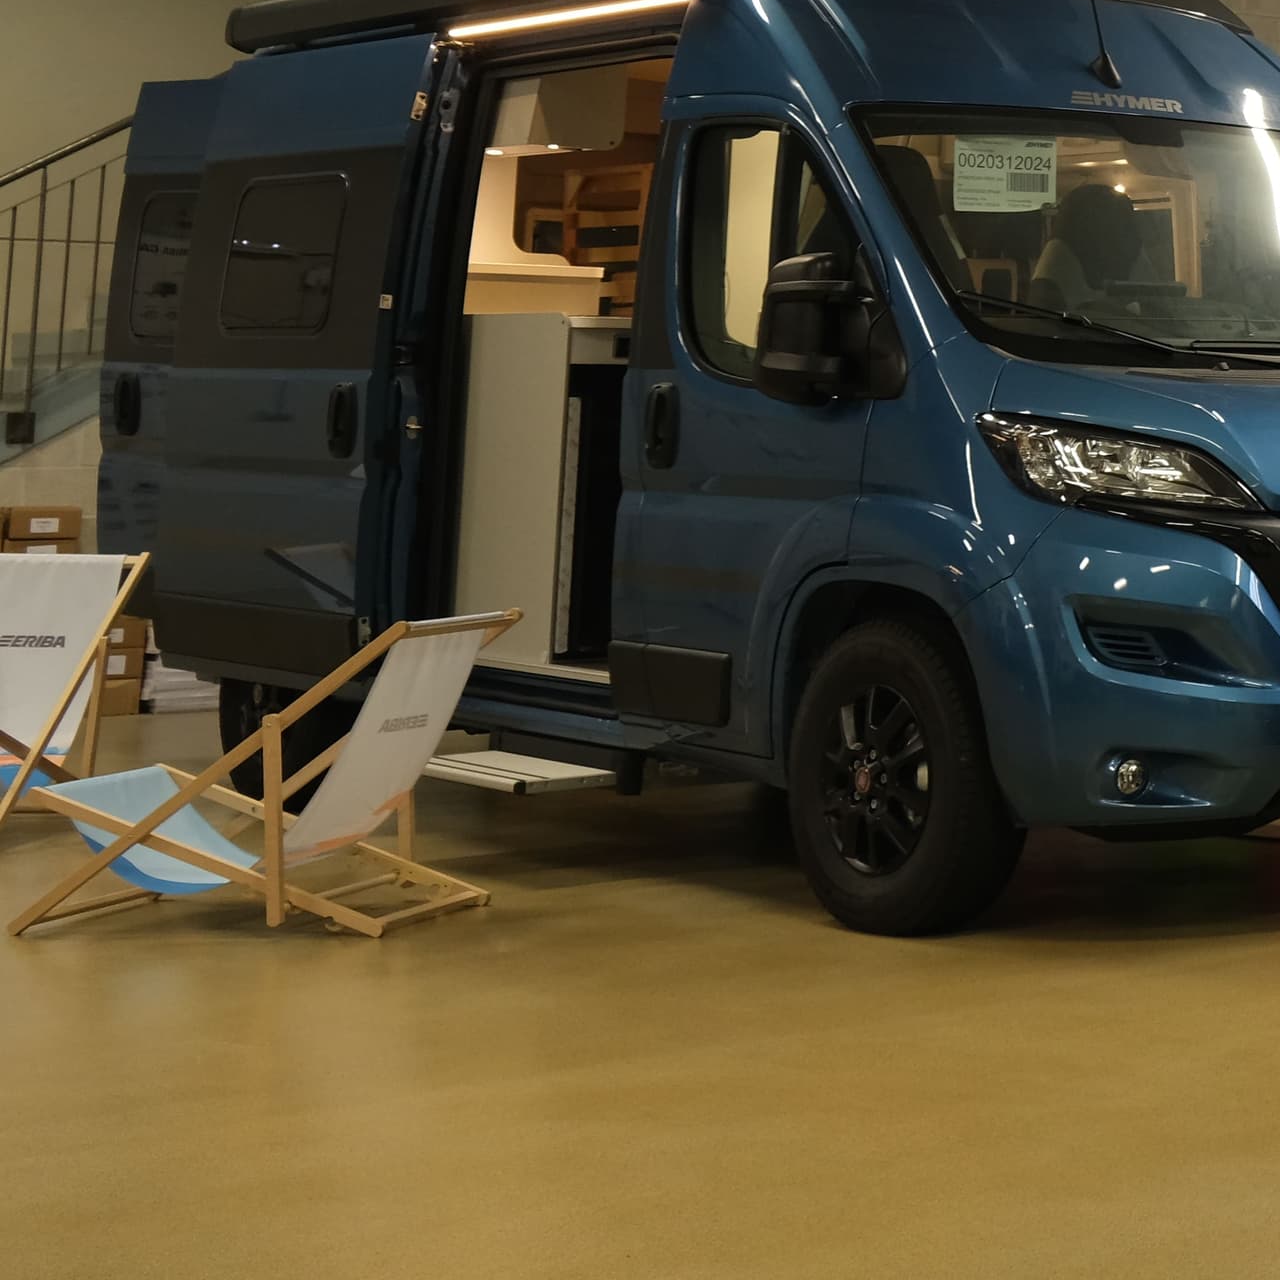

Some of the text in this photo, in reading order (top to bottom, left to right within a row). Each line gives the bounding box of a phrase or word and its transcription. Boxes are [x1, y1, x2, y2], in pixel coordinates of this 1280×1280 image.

[1092, 92, 1184, 114] HYMER
[958, 152, 1053, 172] 0020312024
[10, 634, 67, 648] ERIBA
